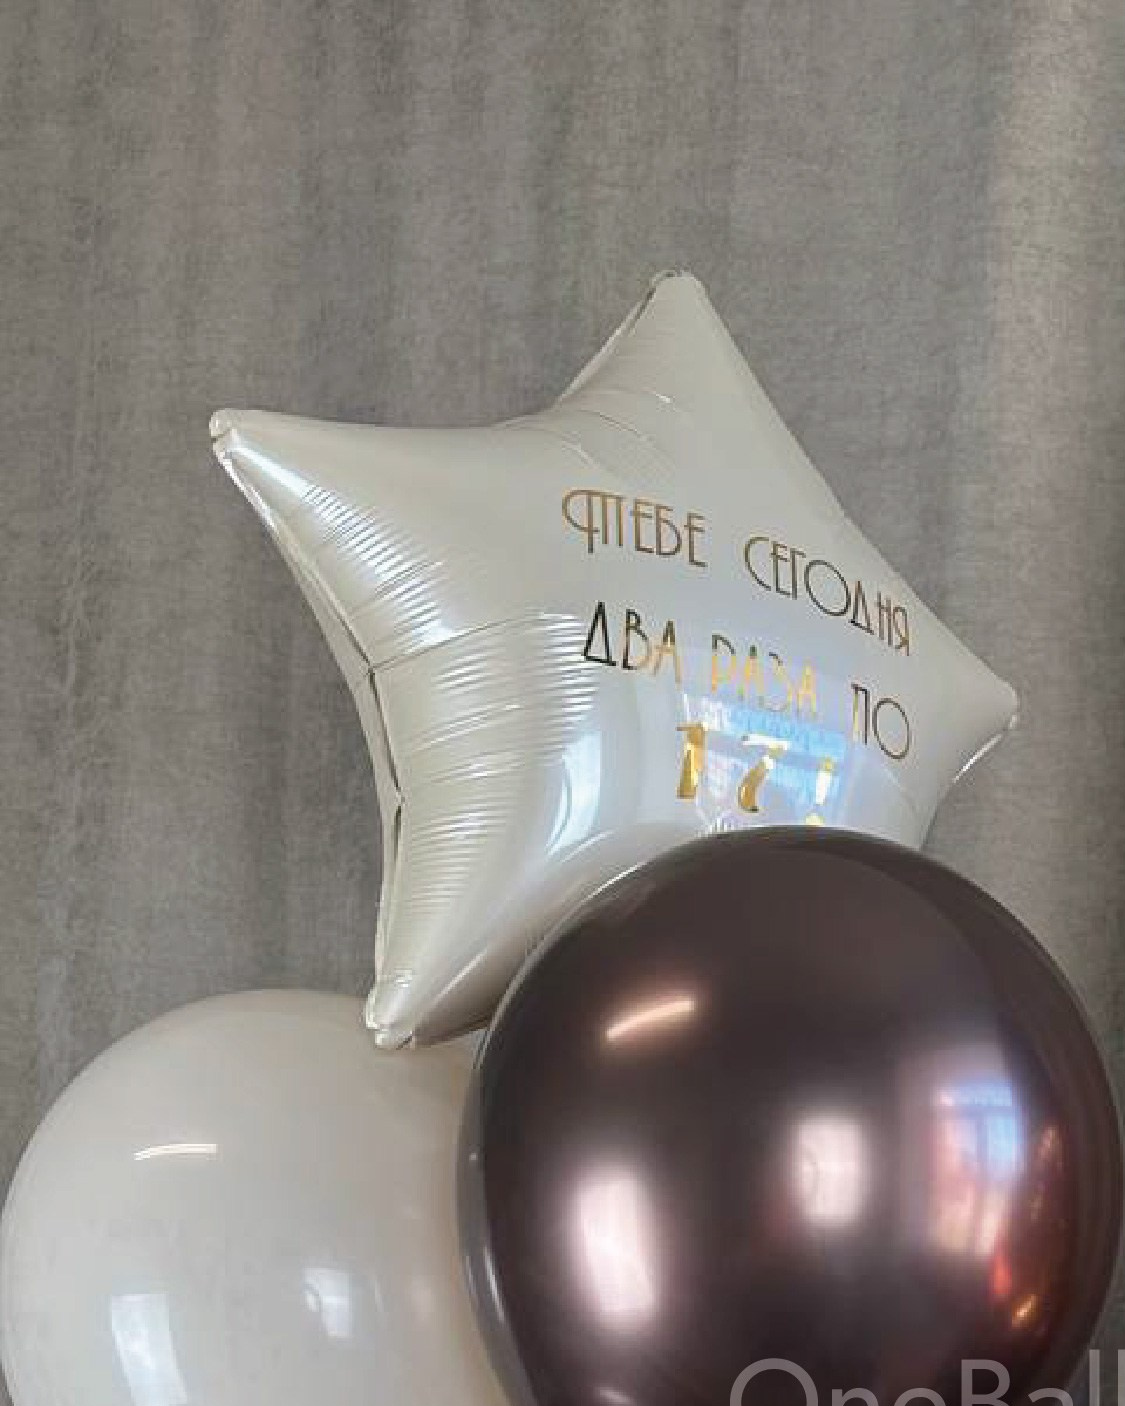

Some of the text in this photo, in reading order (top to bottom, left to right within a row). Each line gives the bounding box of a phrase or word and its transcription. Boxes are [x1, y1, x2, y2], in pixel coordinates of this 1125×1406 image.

[744, 536, 912, 656] СЕГОДНЯ
[581, 601, 912, 760] ДВА РАЗА ПО
